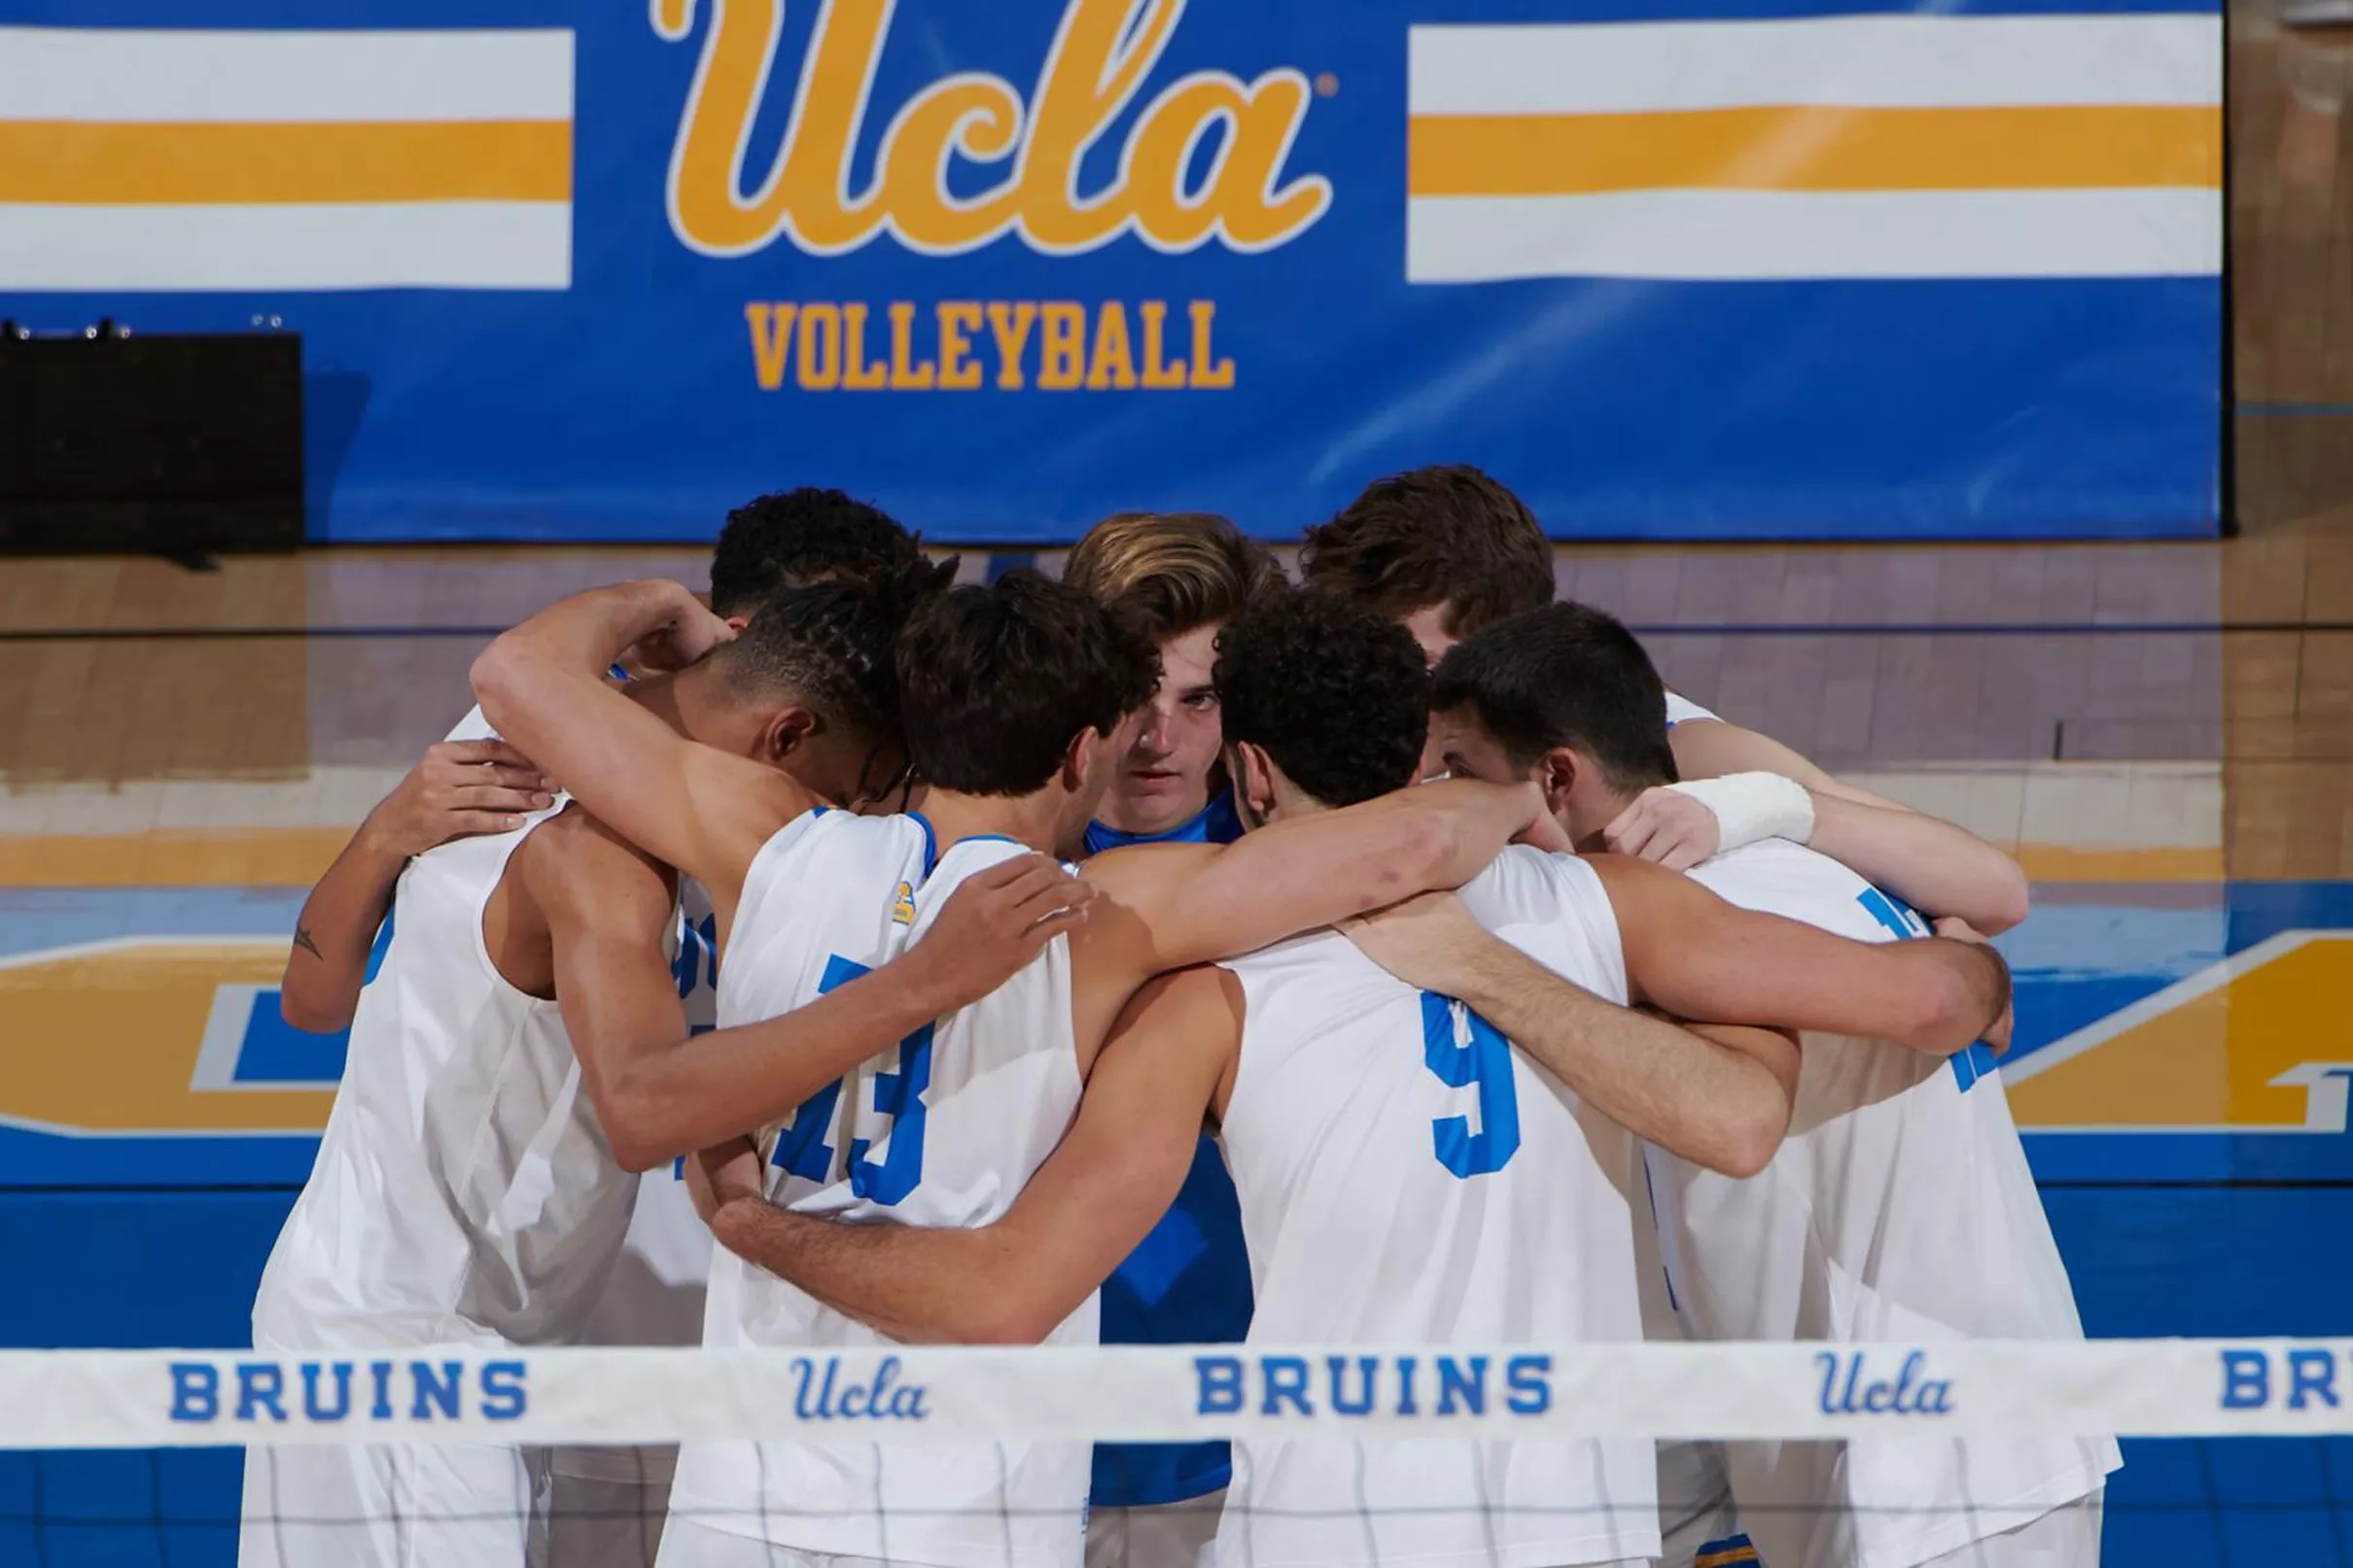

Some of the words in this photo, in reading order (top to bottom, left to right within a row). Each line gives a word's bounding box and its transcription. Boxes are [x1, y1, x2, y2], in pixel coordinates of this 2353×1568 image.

[746, 300, 1235, 391] VOLLEYBALL
[168, 1359, 530, 1423] BRUINS
[790, 1354, 931, 1420] Ucla
[1193, 1353, 1553, 1417] BRUINS
[1814, 1349, 1954, 1415] Ucla
[2221, 1348, 2353, 1411] BR
